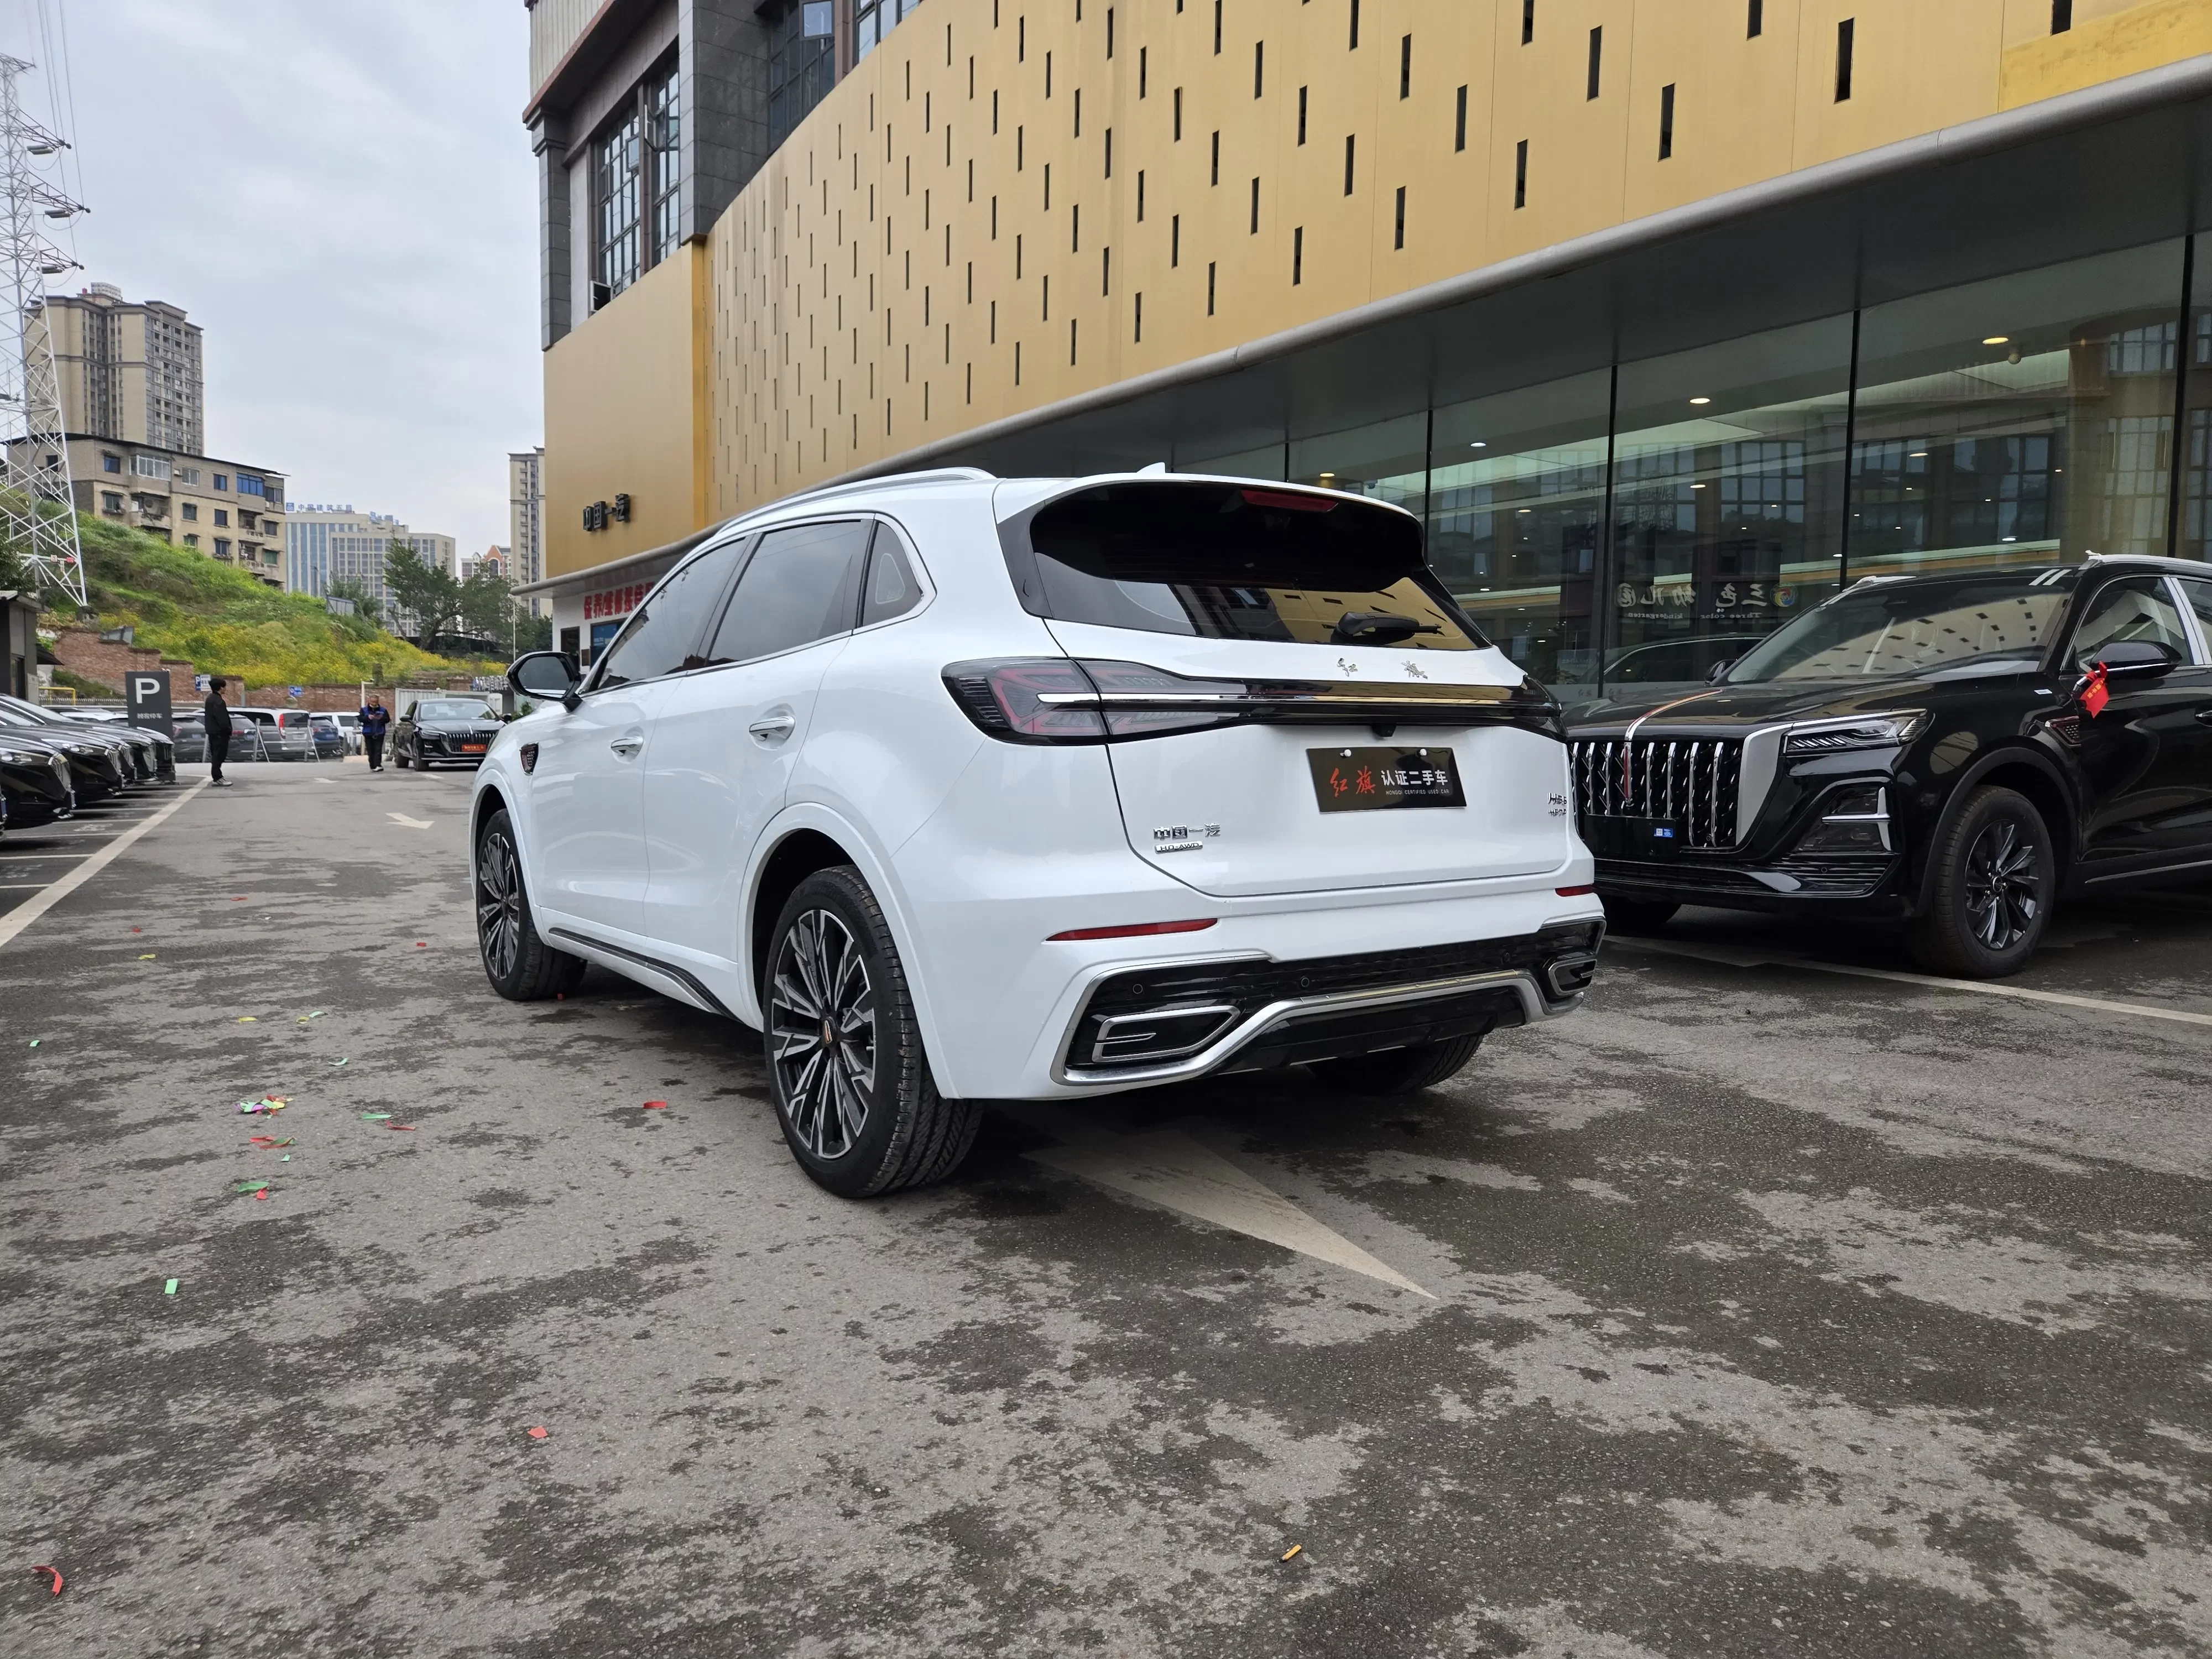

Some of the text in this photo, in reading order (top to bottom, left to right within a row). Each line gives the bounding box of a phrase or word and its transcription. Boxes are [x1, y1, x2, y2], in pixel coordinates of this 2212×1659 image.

[583, 493, 630, 531] 中国一汽
[135, 678, 160, 703] P
[1330, 765, 1448, 797] 红旗 认证二手车
[1153, 823, 1221, 840] 中国一汽
